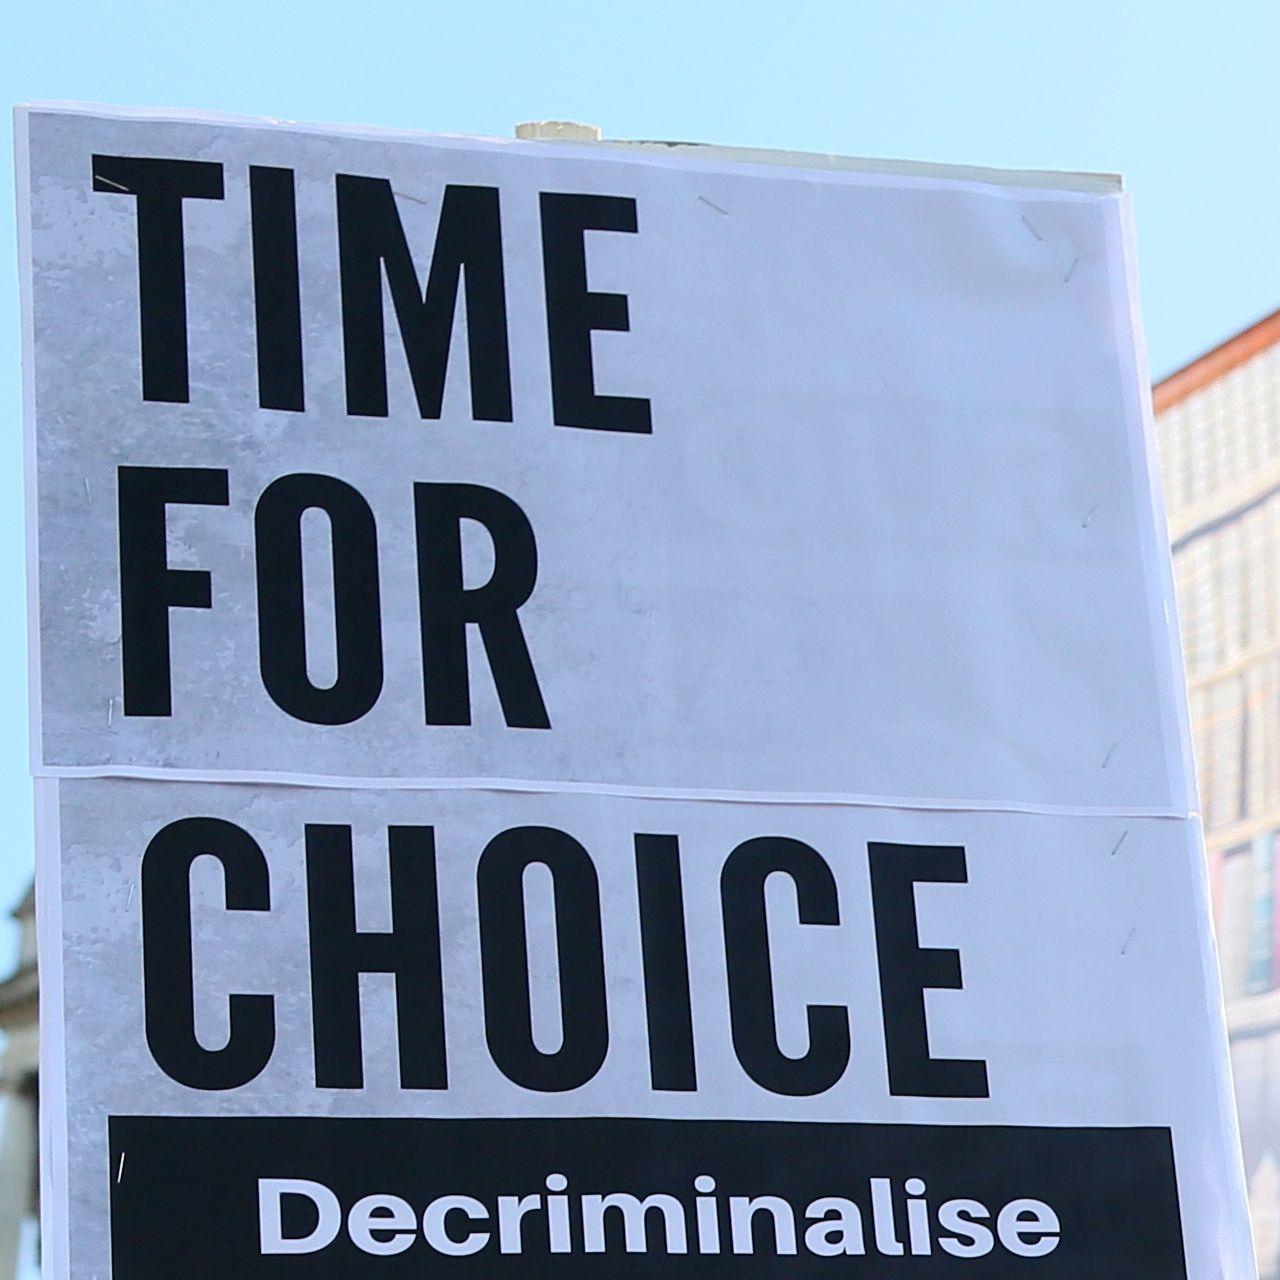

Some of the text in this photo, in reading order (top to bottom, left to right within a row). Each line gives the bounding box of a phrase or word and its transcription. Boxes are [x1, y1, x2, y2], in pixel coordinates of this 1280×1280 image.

[92, 154, 653, 435] TIME
[117, 465, 552, 729] FOR
[141, 816, 990, 1100] CHOICE
[257, 1176, 1061, 1258] Decriminalise
